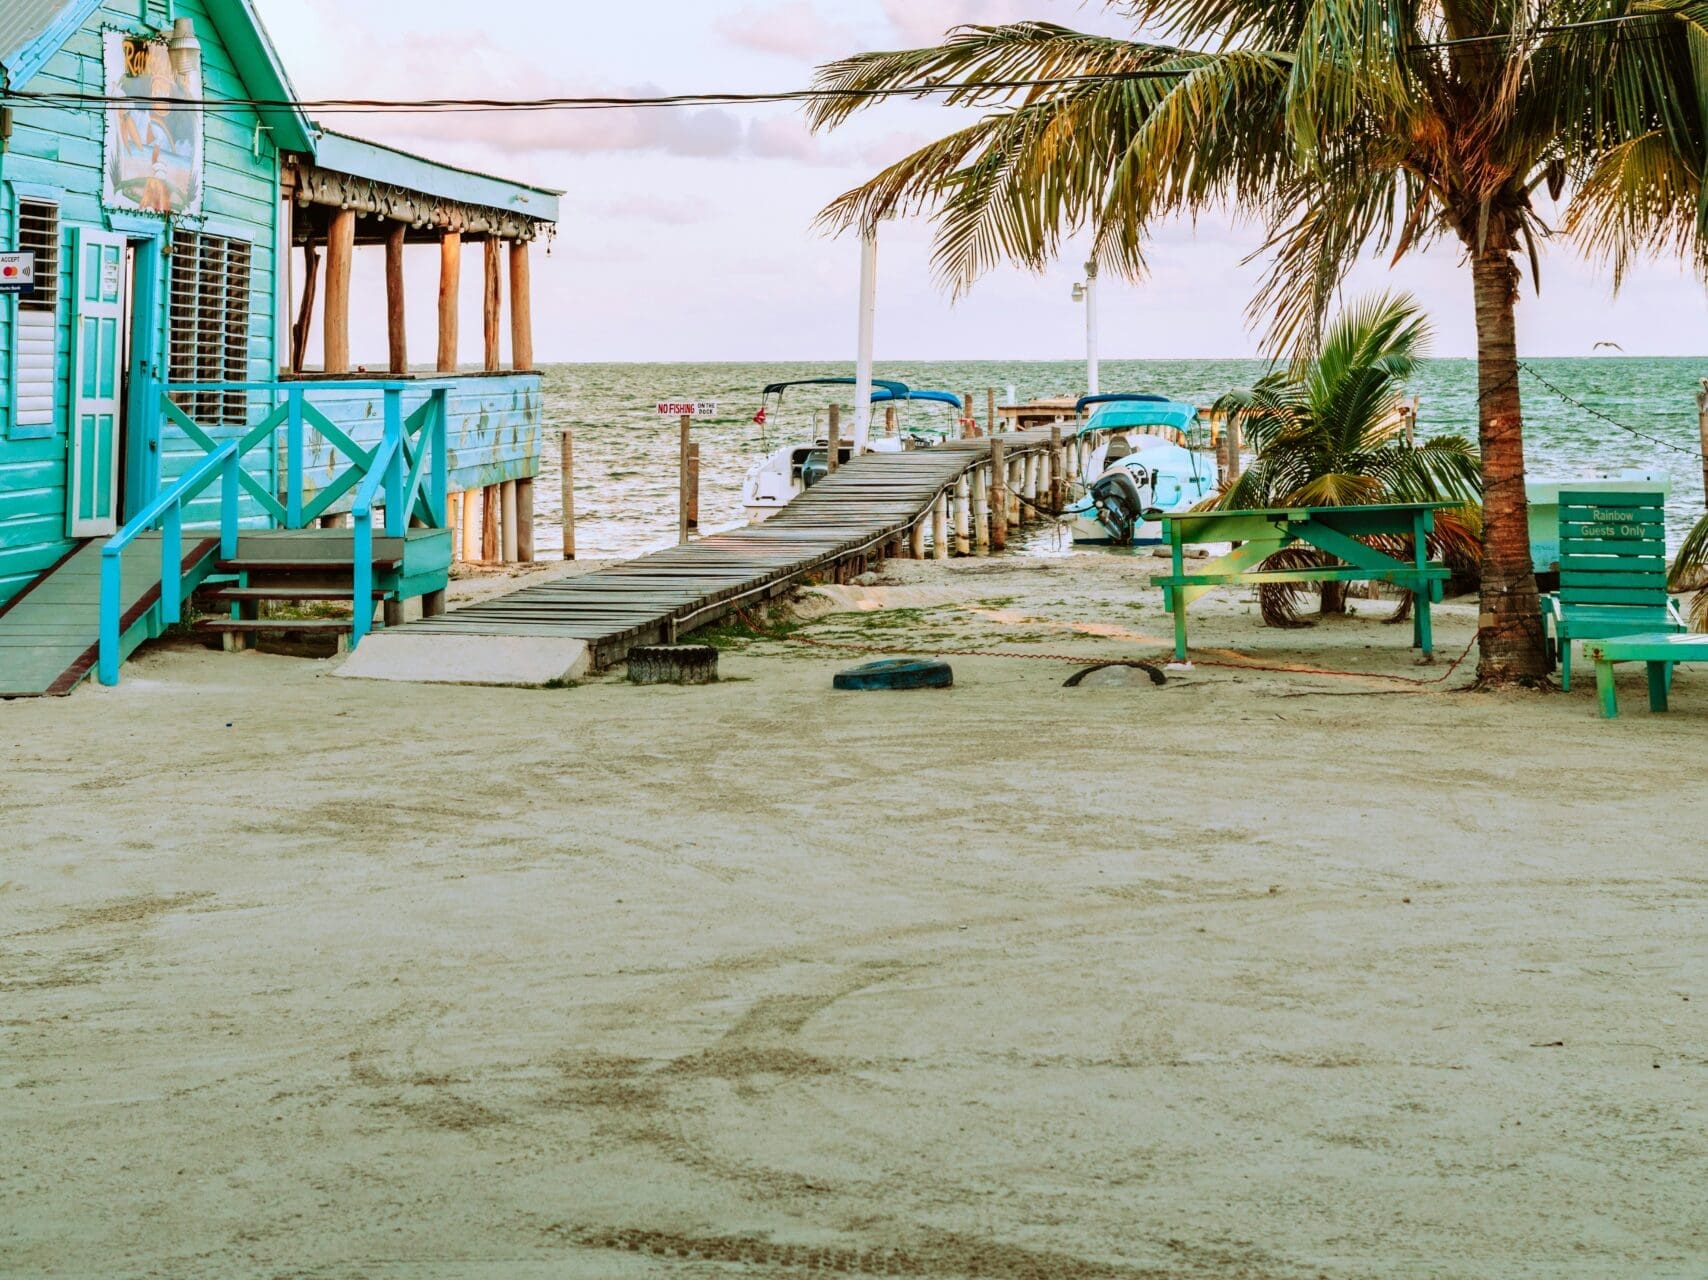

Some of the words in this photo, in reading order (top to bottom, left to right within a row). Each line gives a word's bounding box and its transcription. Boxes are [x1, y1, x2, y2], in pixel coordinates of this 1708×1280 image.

[658, 403, 668, 414] NO
[669, 403, 695, 414] FISHING
[1593, 509, 1633, 521] Rainbow
[1581, 525, 1615, 536] Guests
[1621, 525, 1645, 537] Only
